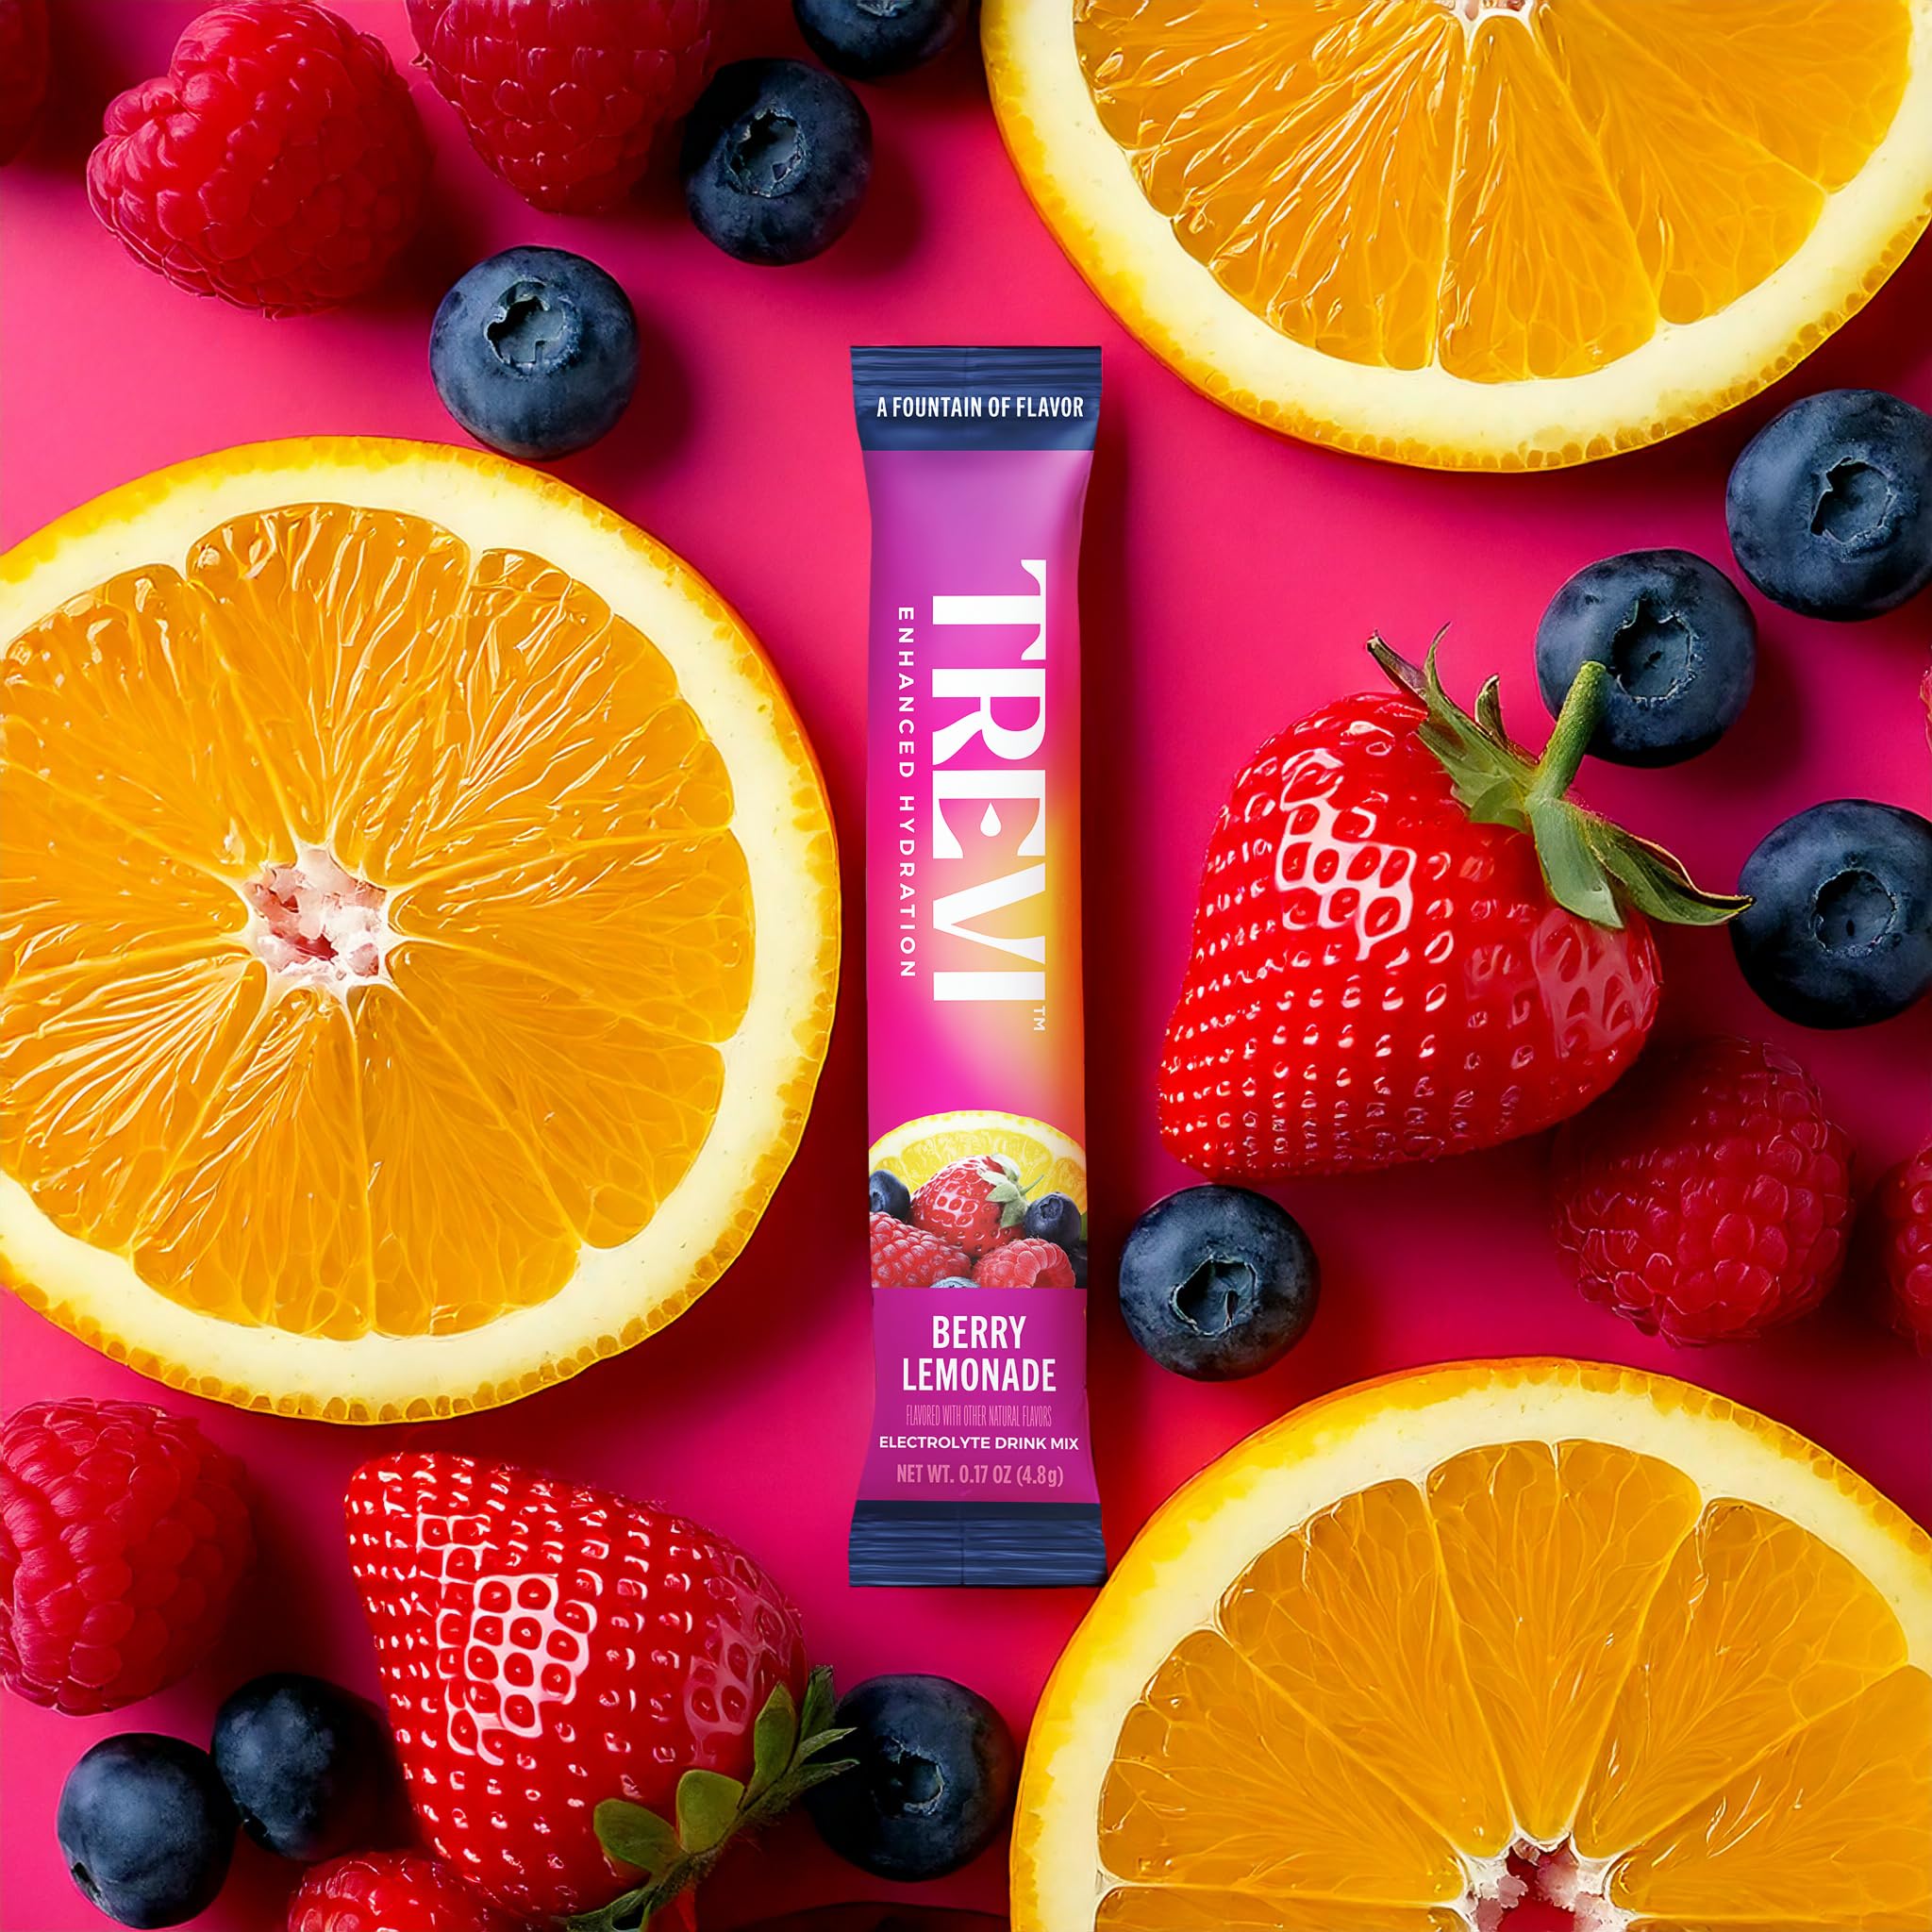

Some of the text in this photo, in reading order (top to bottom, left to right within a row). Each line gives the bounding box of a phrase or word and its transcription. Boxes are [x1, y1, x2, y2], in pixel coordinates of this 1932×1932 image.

[876, 396, 1084, 417] A FOUNTAIN OF FLAVOR
[898, 607, 916, 977] ENHANCED HYDRATION
[932, 559, 1046, 1001] TREVI
[932, 1315, 1026, 1349] BERRY
[903, 1357, 1057, 1391] LEMONADE
[906, 1404, 1052, 1427] FLAVORED WITH OTHER NATURAL FLAVORS
[879, 1436, 1079, 1450] ELECTROLYTE DRINK MIX
[896, 1464, 1064, 1488] NET WT. 0.17 OZ (4.8g)
